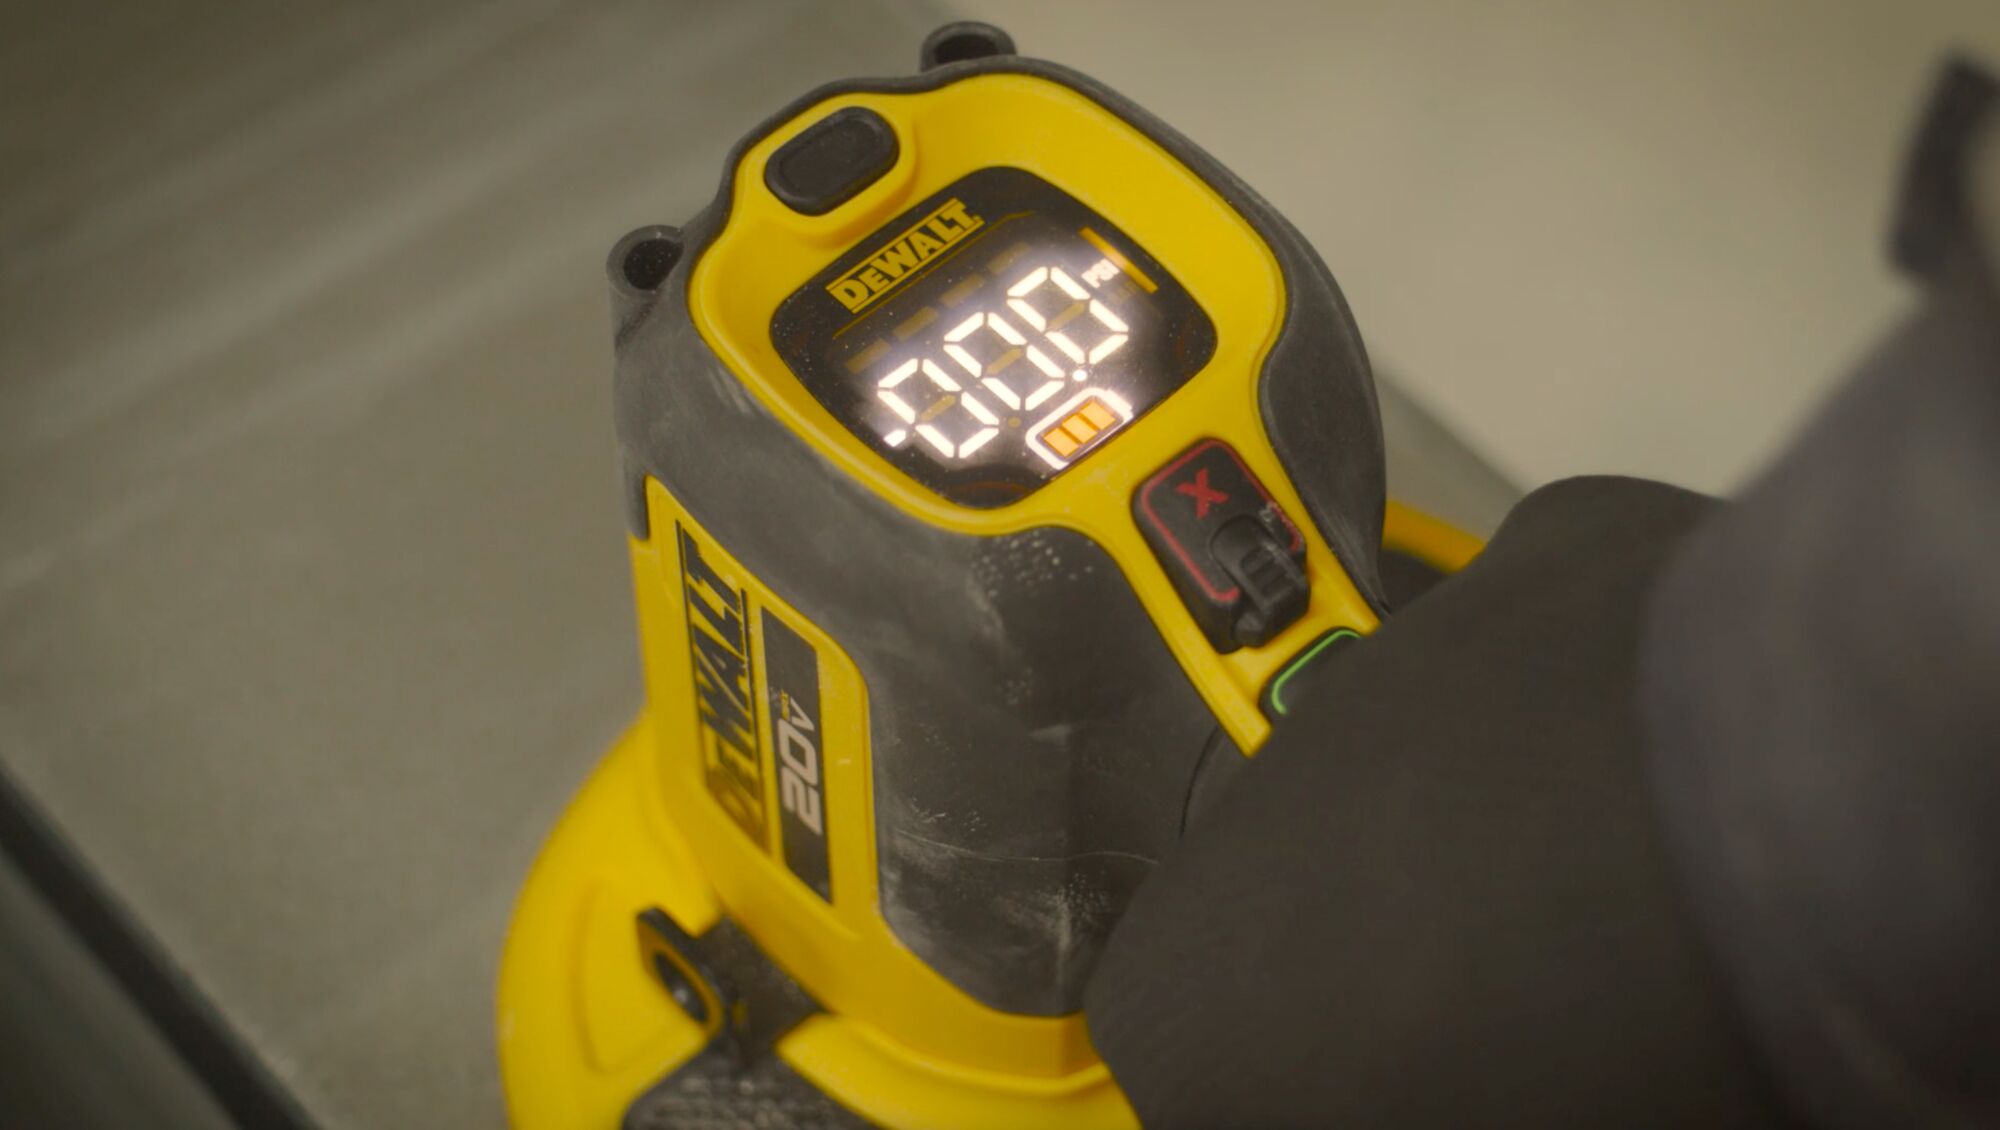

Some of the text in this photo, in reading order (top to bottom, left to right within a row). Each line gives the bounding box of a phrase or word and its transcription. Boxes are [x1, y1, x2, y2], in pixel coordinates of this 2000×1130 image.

[828, 199, 984, 311] DEWALT
[1081, 259, 1120, 288] PSI
[777, 698, 823, 835] 20V
